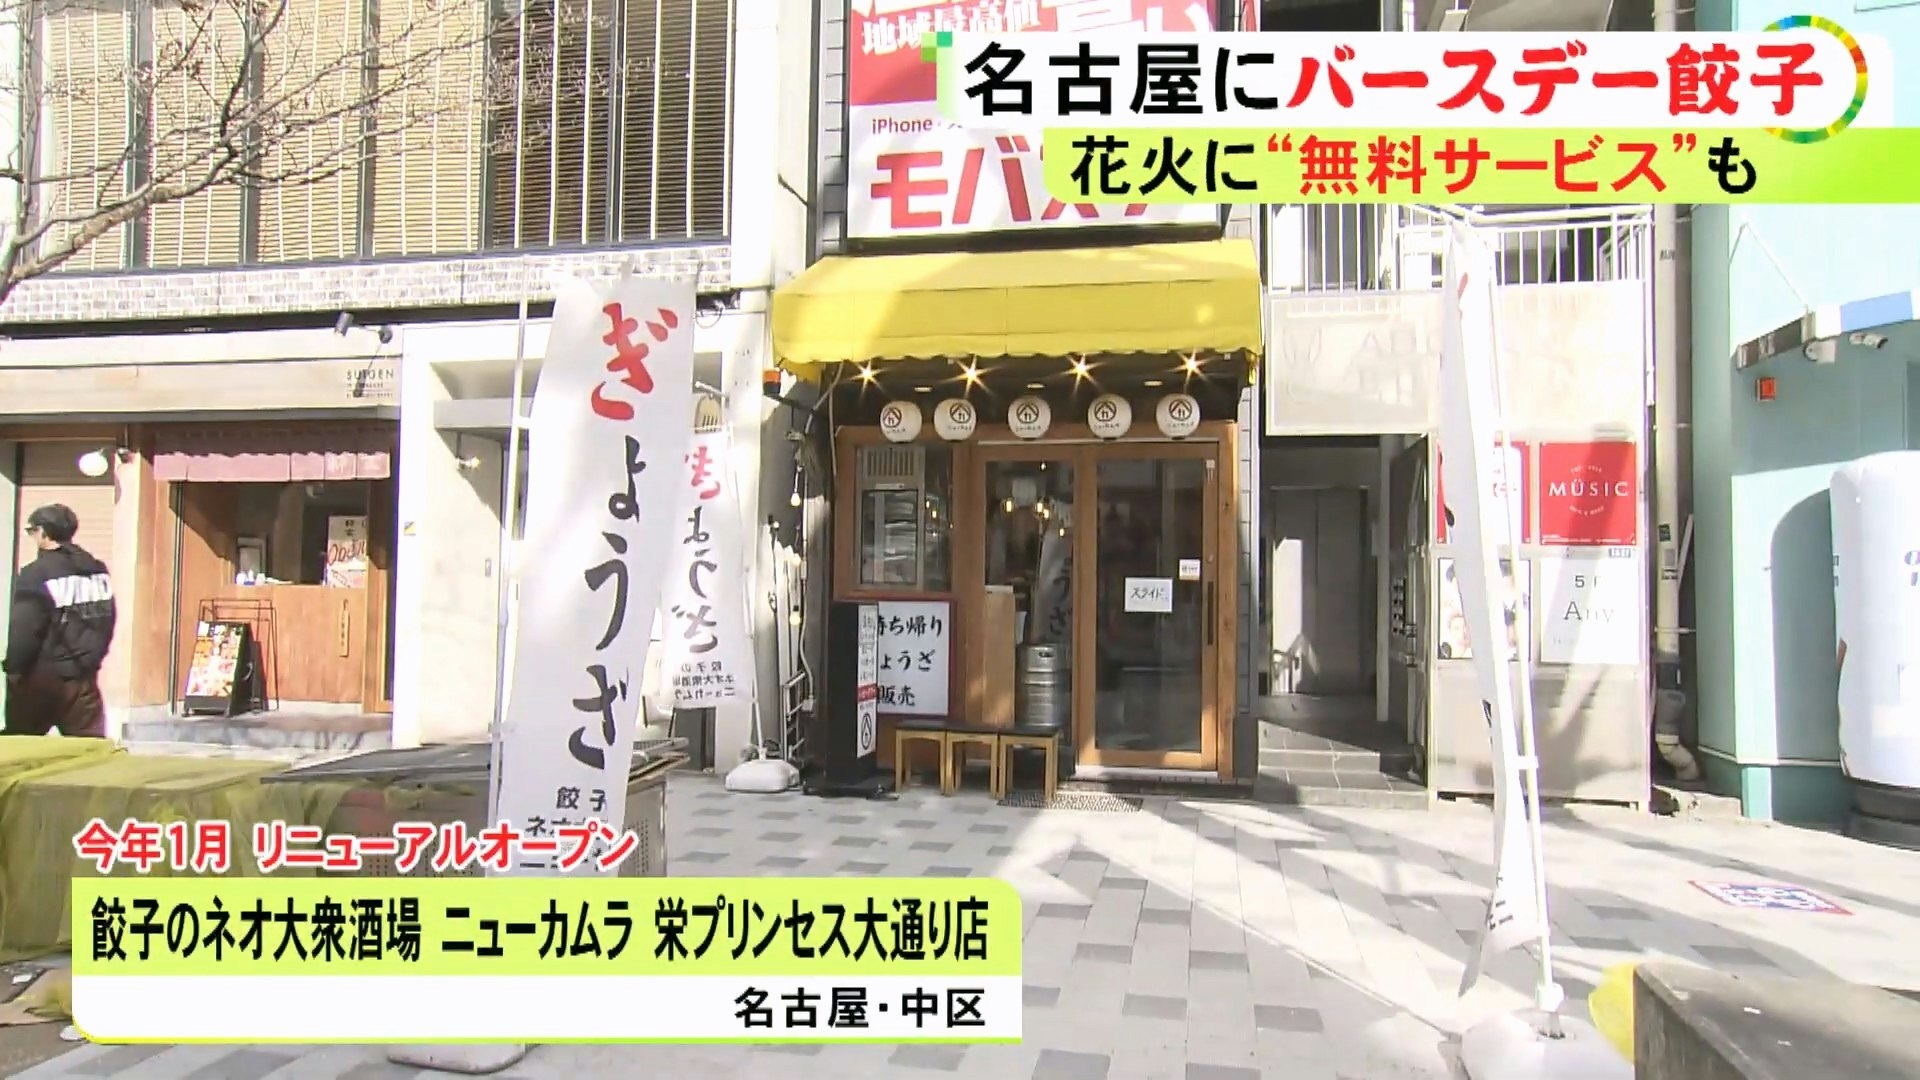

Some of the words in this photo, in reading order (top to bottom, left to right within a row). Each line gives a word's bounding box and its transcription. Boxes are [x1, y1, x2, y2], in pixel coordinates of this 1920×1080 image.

[568, 302, 679, 770] ぎょうざ
[1548, 478, 1629, 497] MÜSIC
